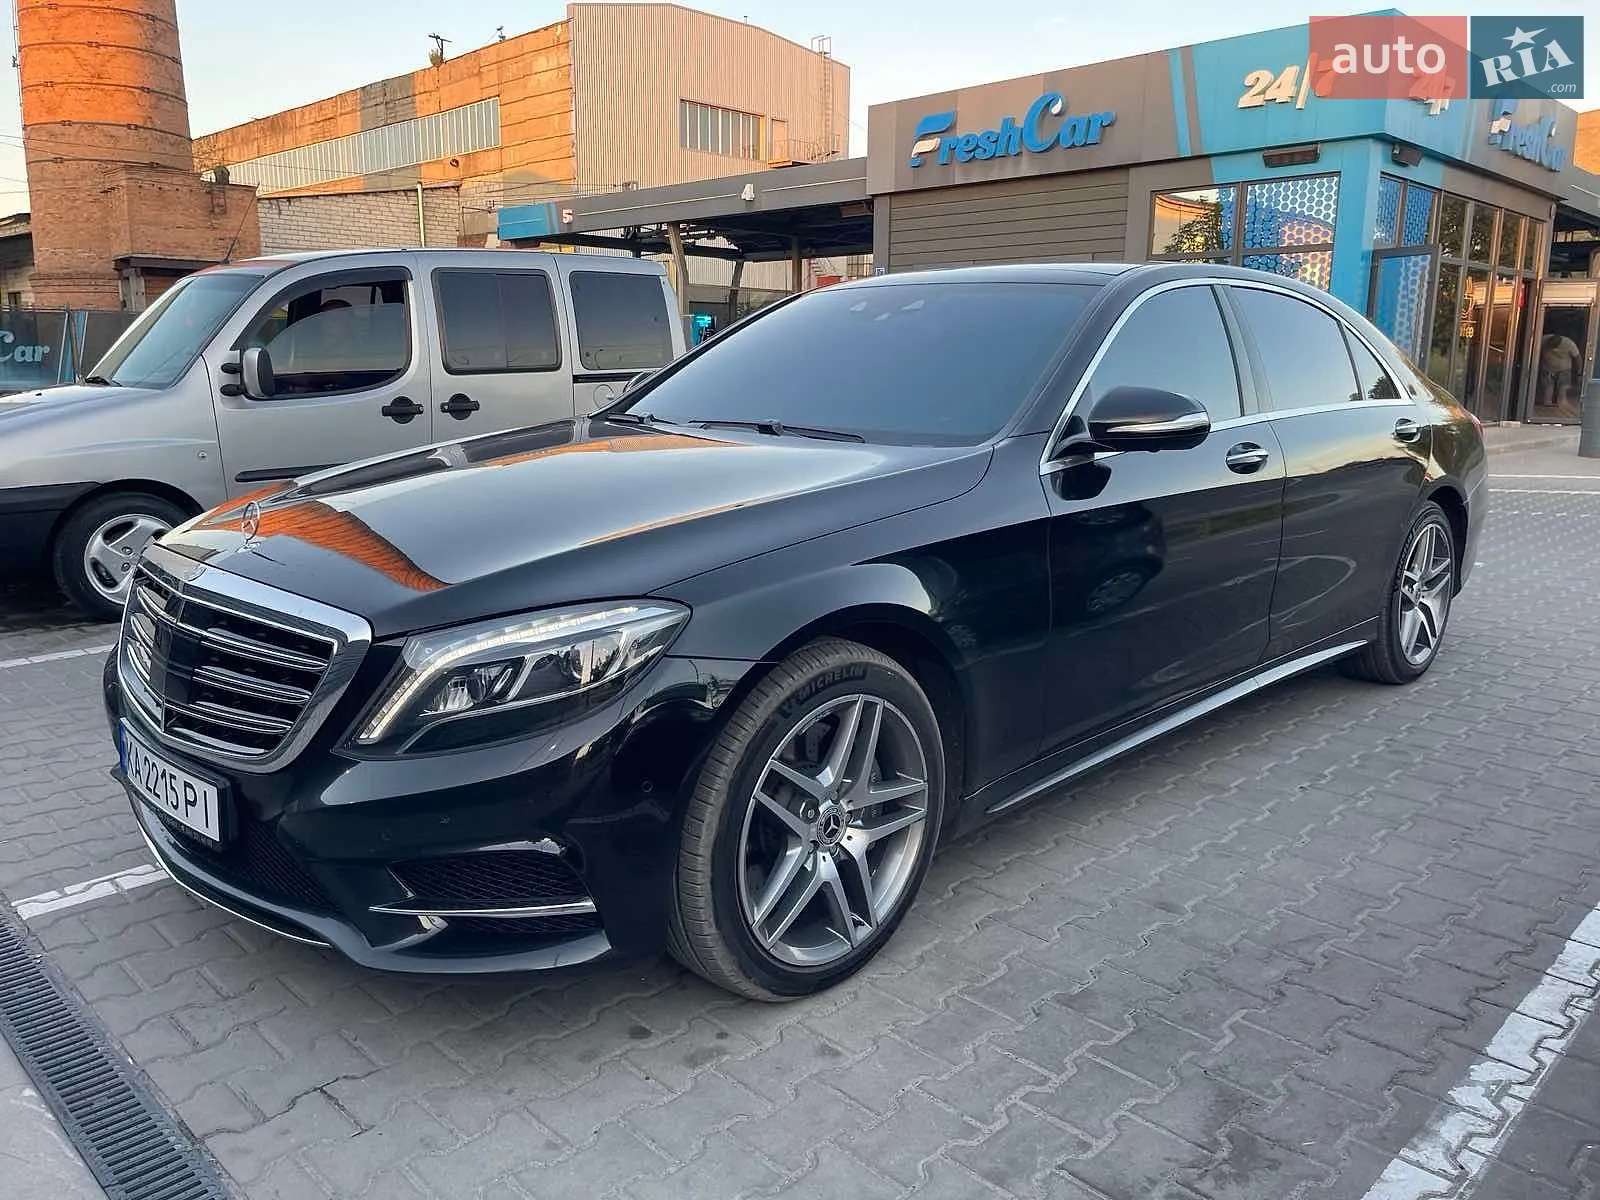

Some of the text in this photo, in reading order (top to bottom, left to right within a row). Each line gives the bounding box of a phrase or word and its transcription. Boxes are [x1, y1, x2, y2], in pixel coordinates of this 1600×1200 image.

[741, 183, 755, 201] 4
[562, 208, 574, 224] 5
[143, 756, 179, 811] 2215
